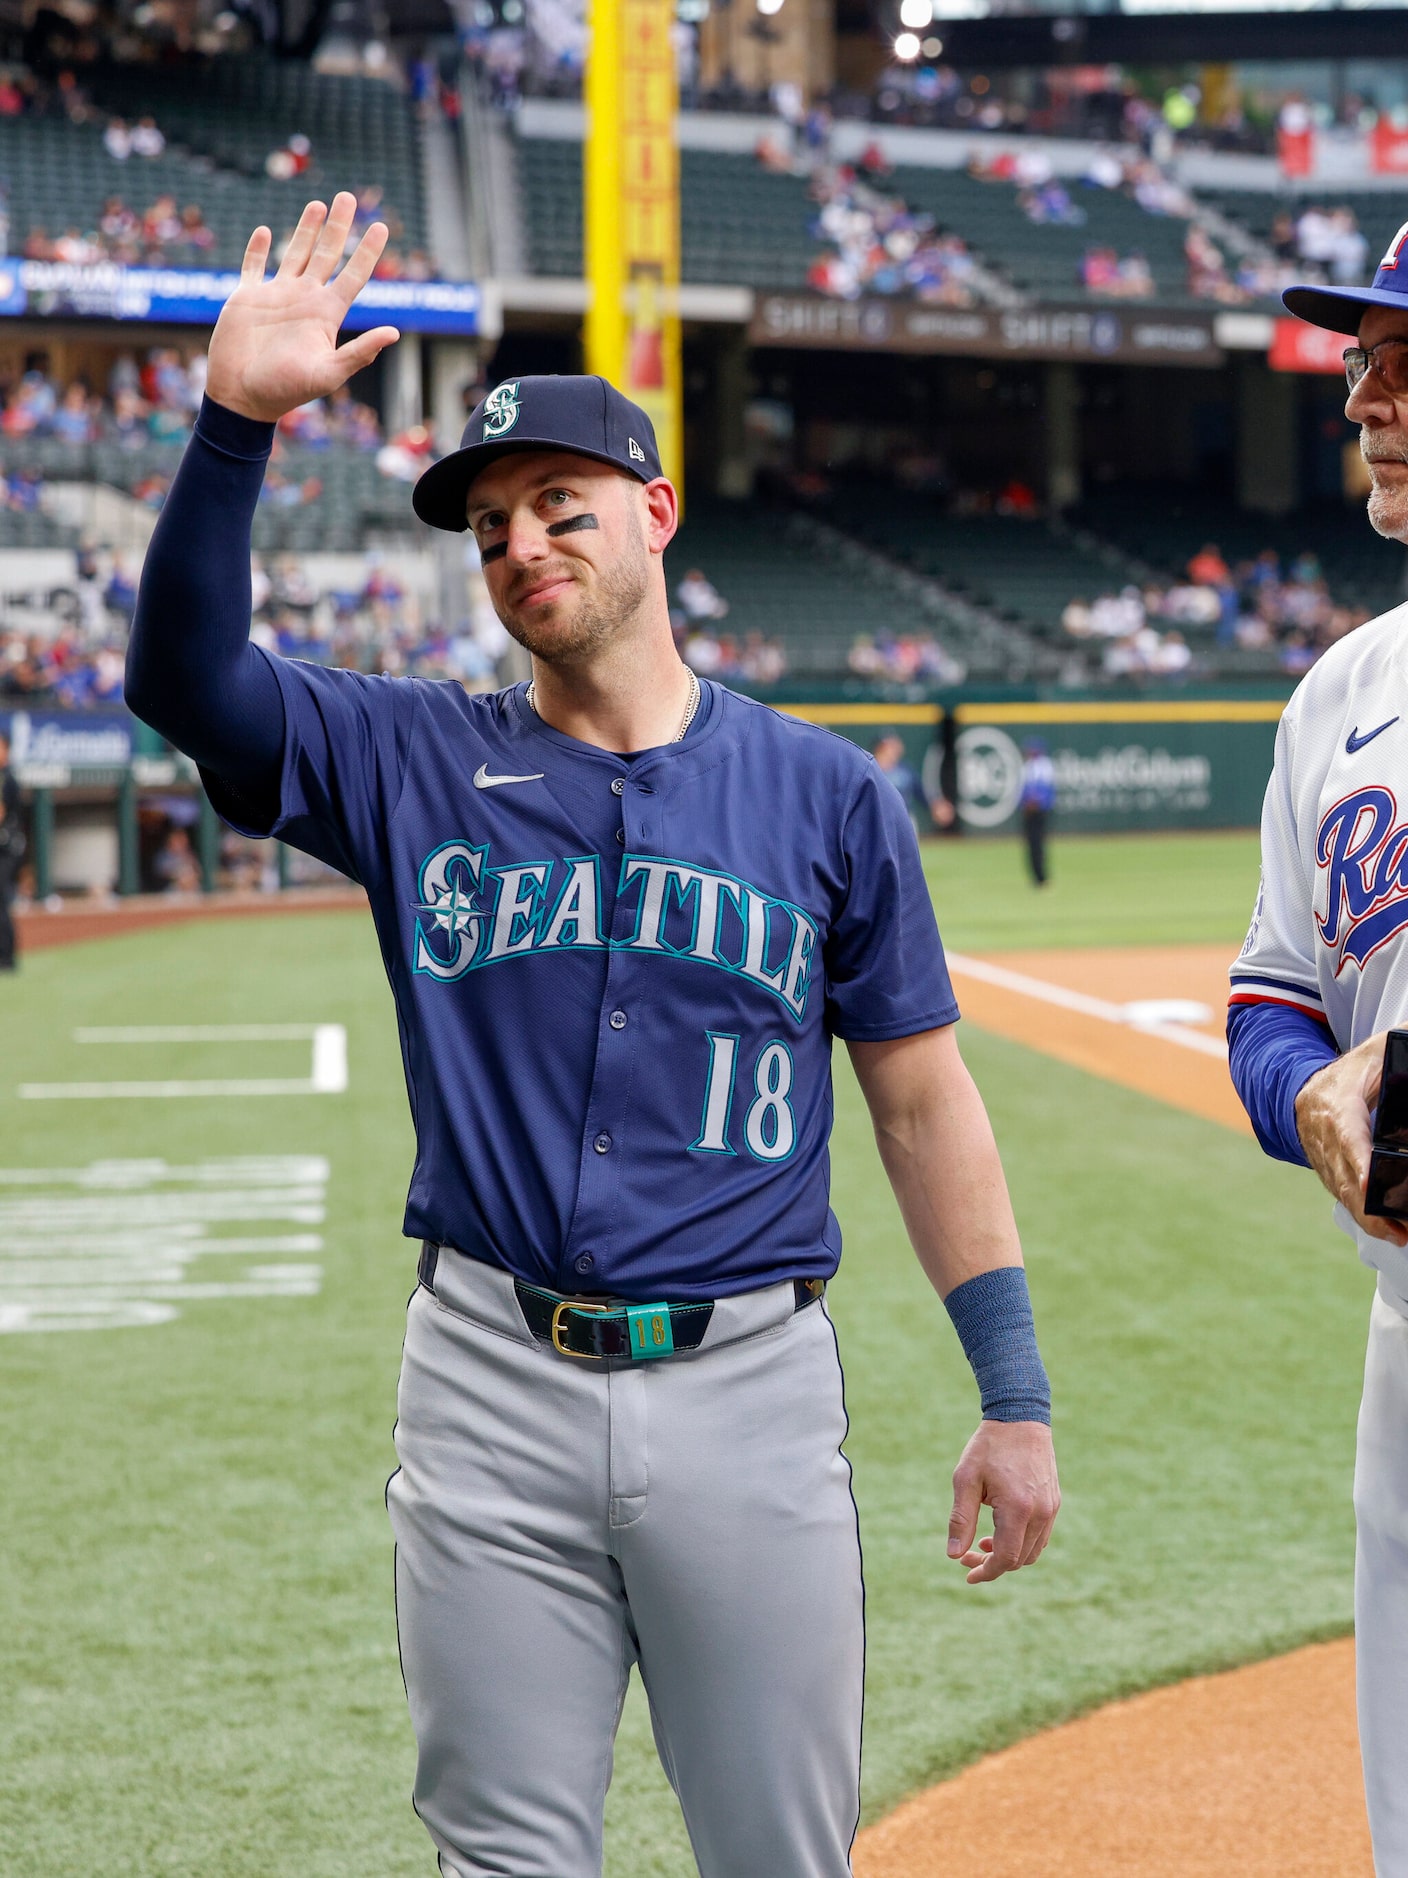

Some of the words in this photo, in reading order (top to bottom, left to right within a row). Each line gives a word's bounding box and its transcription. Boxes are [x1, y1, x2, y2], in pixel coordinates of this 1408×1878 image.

[411, 839, 820, 1024] SEATTLE
[687, 1030, 797, 1163] 18
[635, 1315, 666, 1348] 18
